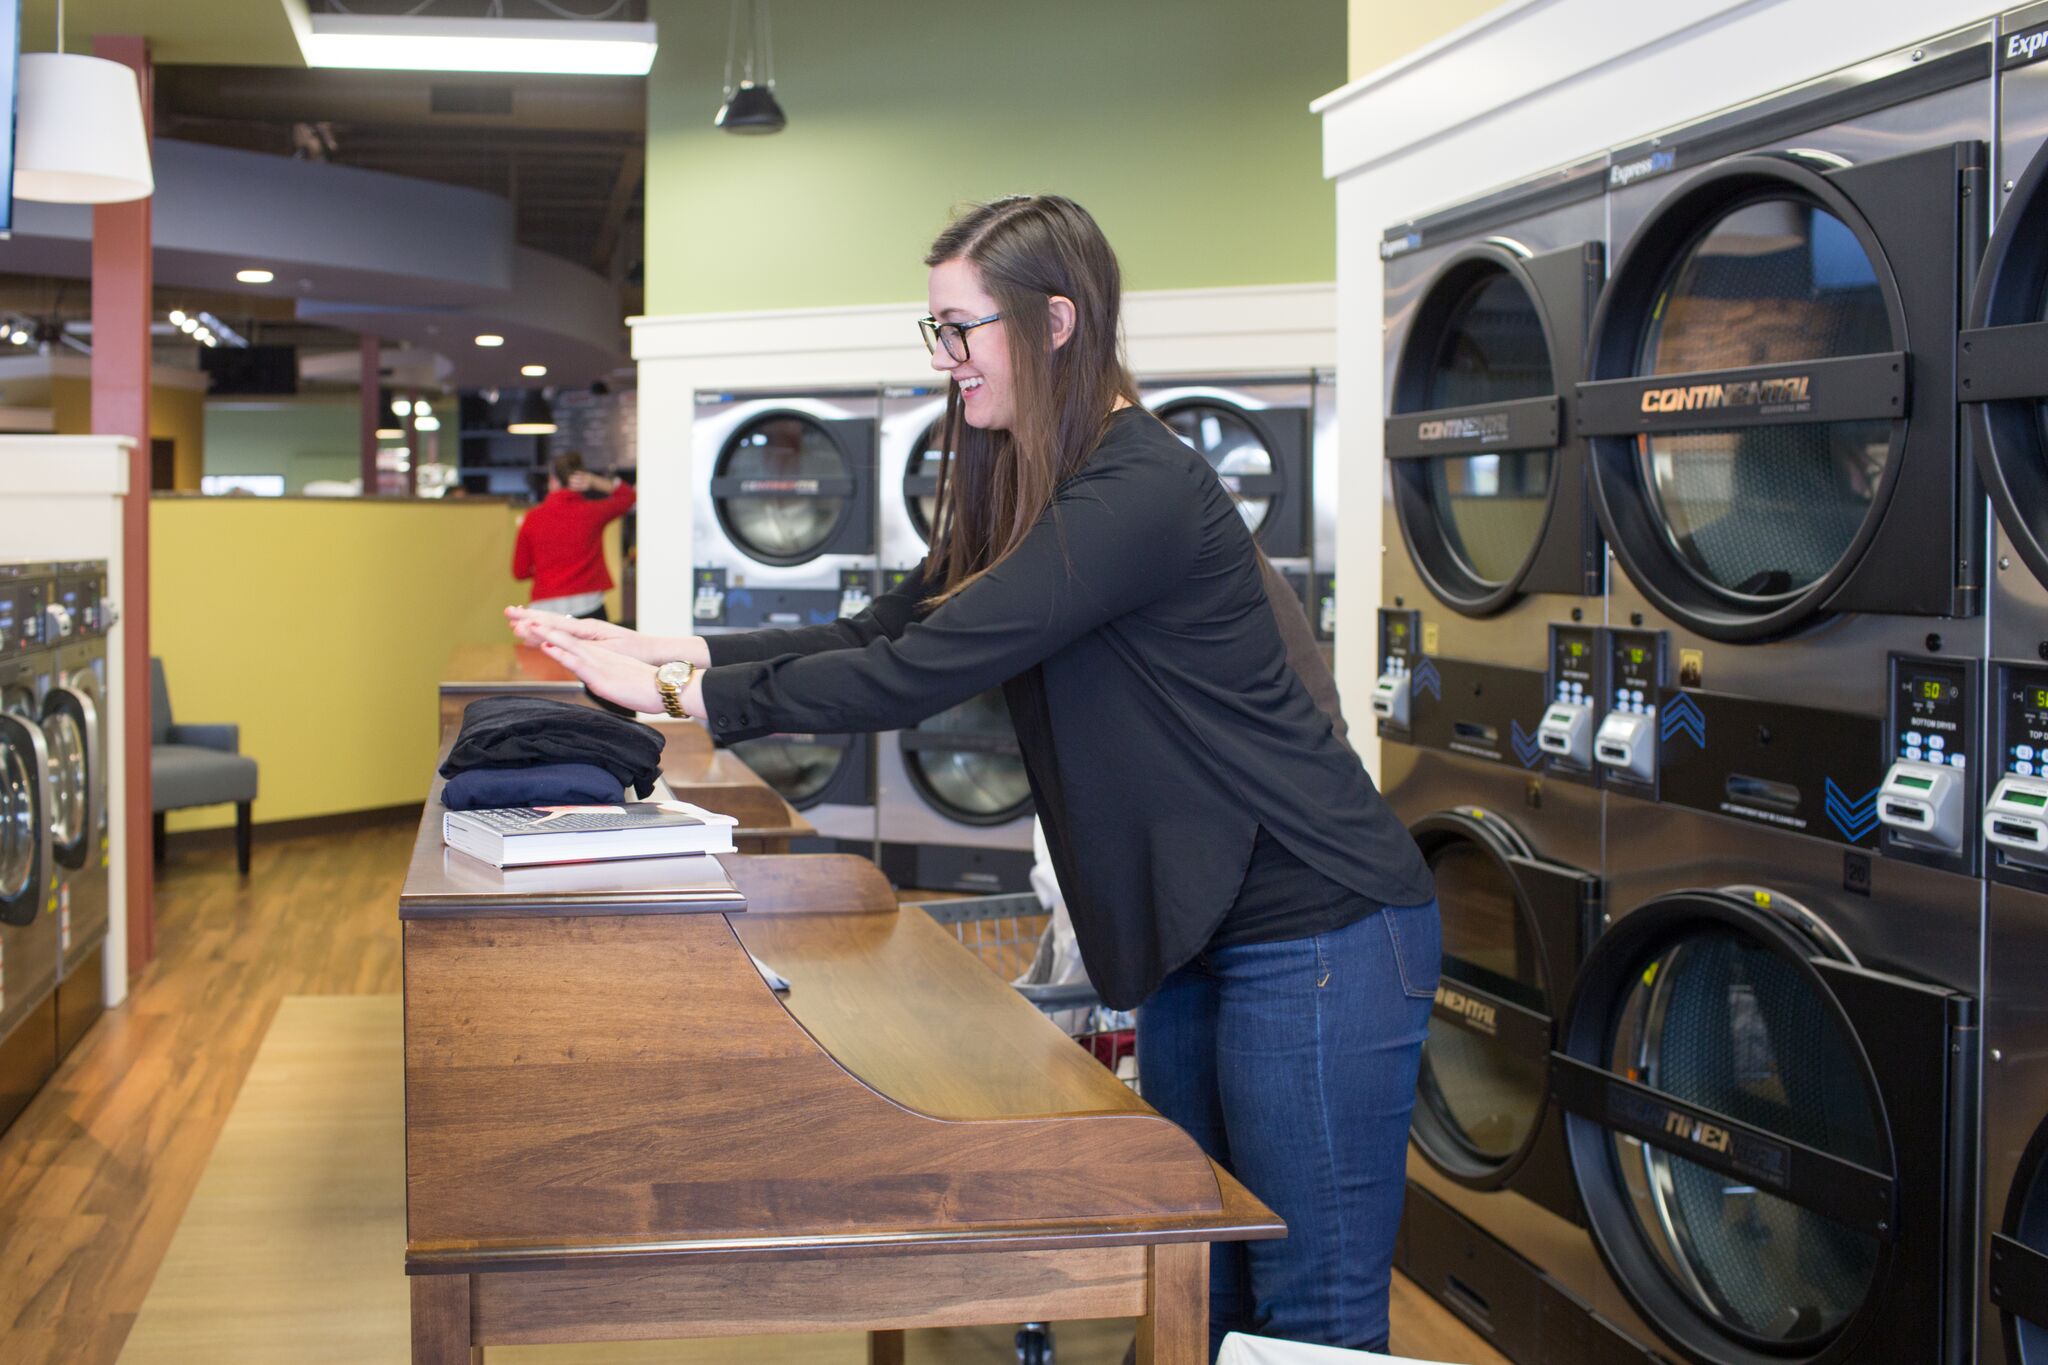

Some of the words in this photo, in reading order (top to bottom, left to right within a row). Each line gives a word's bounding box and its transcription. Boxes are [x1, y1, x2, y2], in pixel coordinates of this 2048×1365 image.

[1641, 375, 1811, 413] CONTINENTAL
[1923, 681, 1940, 699] 50
[1911, 716, 1936, 729] BOTTOM
[2029, 730, 2043, 740] TOP
